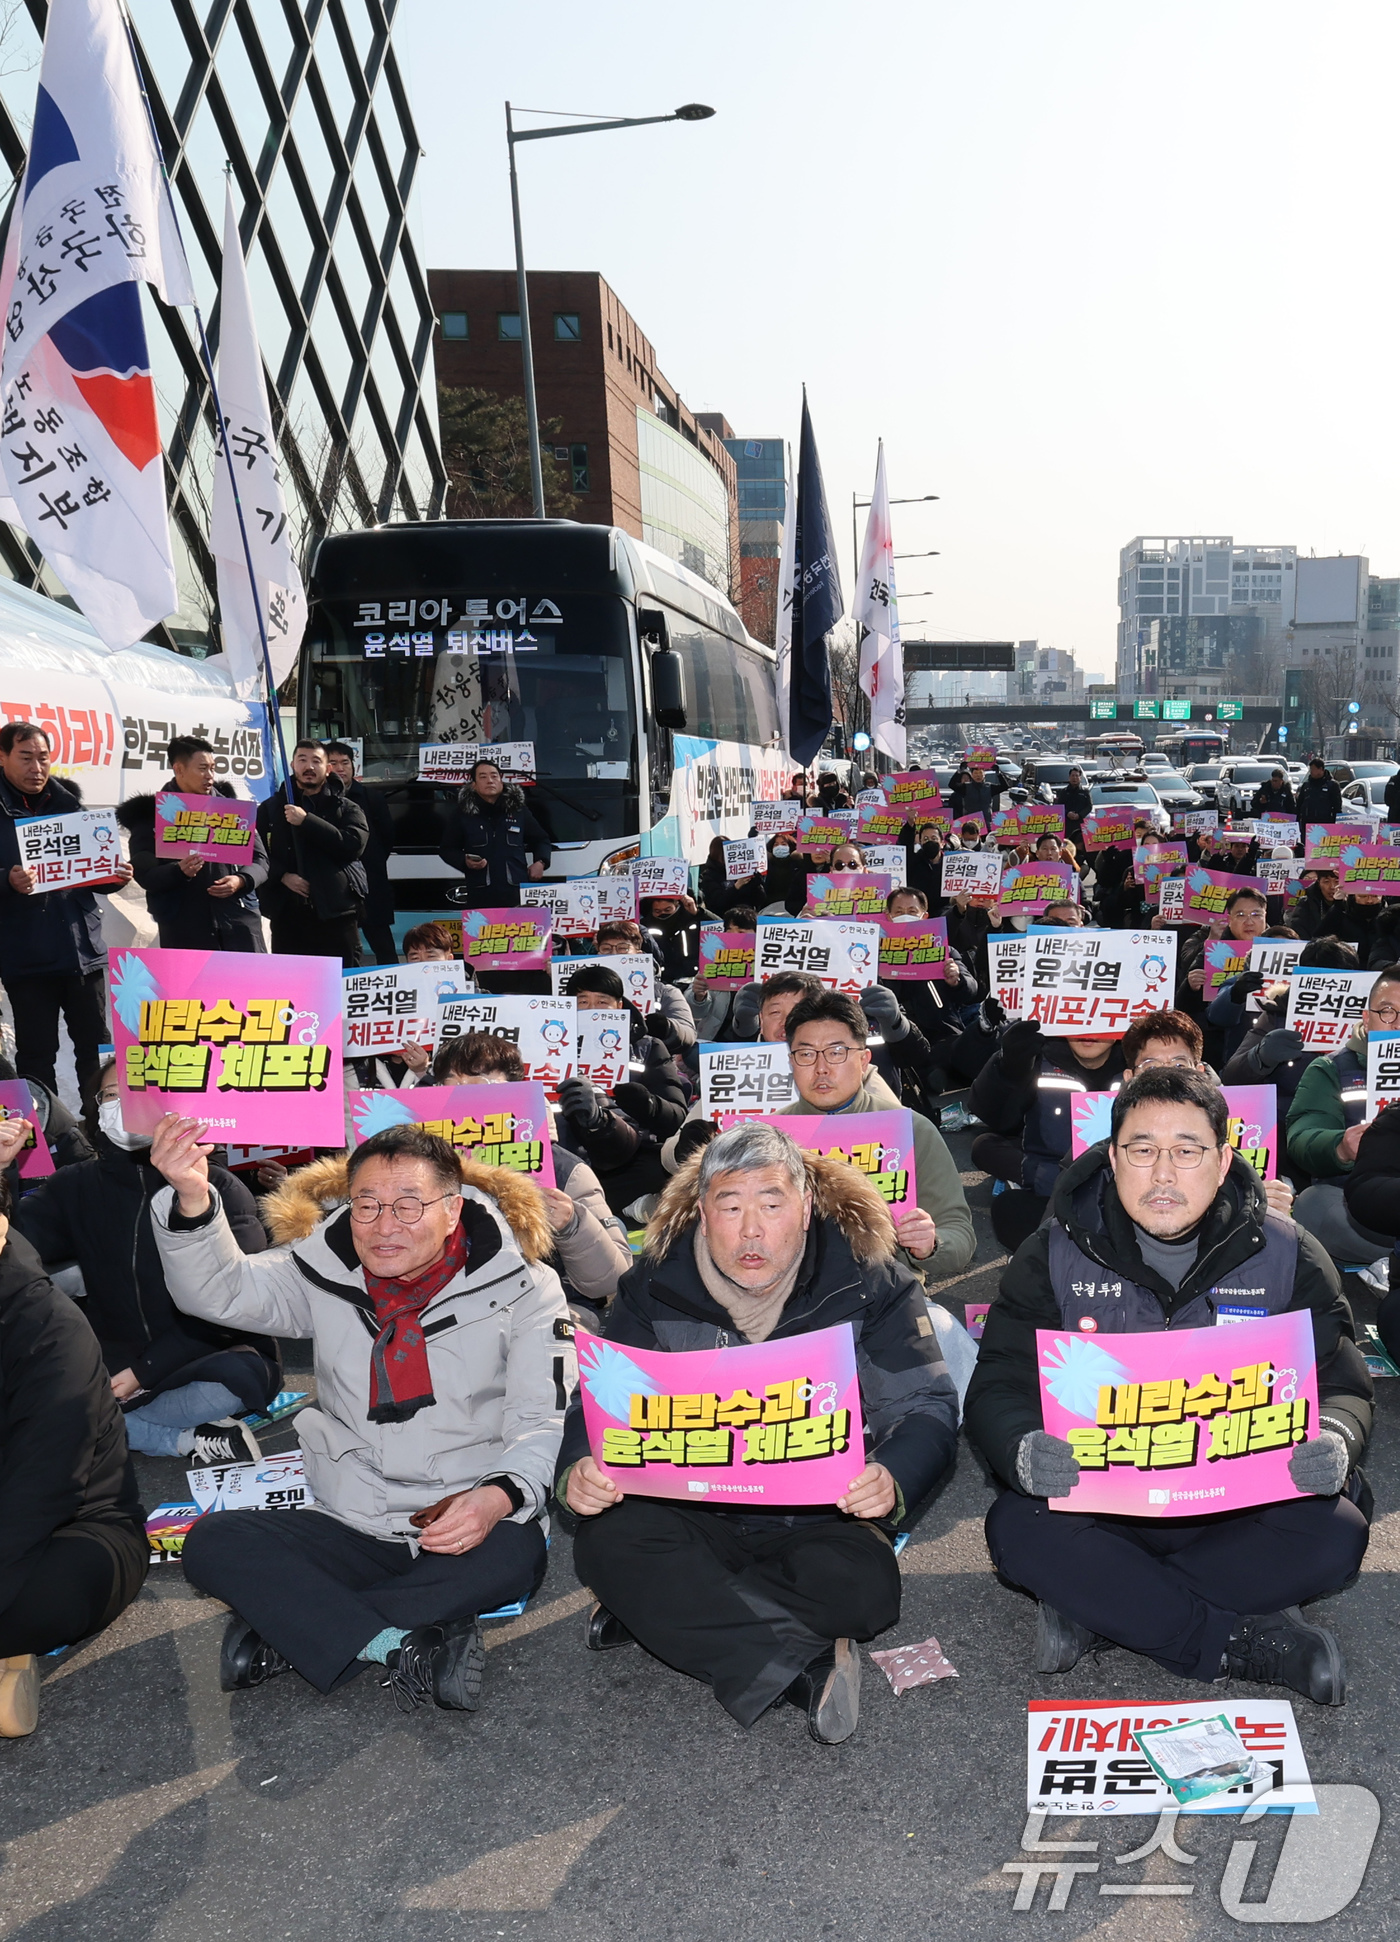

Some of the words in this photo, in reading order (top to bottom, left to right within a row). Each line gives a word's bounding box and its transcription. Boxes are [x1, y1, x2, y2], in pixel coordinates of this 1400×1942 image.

[15, 372, 111, 506] 노동조합
[353, 599, 452, 627] 코리아
[460, 598, 563, 626] 투어스
[365, 630, 434, 658] 윤석열
[447, 629, 538, 655] 퇴진버스
[424, 750, 478, 766] 내란공범
[892, 779, 928, 794] 내란수괴
[889, 792, 914, 804] 윤석열
[914, 787, 936, 801] 체포!
[89, 811, 112, 821] 한국노총
[175, 810, 240, 830] 내란수괴
[754, 810, 782, 820] 윤석열
[870, 816, 904, 826] 내란수괴
[1026, 813, 1060, 825] 내란수괴
[1186, 817, 1205, 825] 윤석열
[22, 823, 63, 838] 내란수괴
[808, 826, 843, 836] 내란수괴
[862, 824, 890, 834] 윤석열
[1020, 823, 1046, 834] 윤석열
[1094, 824, 1125, 836] 내란수괴
[1256, 827, 1281, 839] 윤석열
[162, 826, 209, 843] 윤석열
[211, 829, 252, 847] 체포!
[801, 835, 827, 844] 윤석열
[829, 836, 847, 845] 체포!
[1091, 834, 1113, 844] 윤석열
[1113, 830, 1133, 842] 체포!
[1320, 834, 1361, 847] 내란수괴
[25, 834, 81, 860] 윤석열
[726, 843, 748, 851] 내란수괴
[1310, 846, 1340, 859] 윤석열
[727, 850, 755, 863] 윤석열
[945, 855, 970, 864] 내란수괴
[29, 853, 120, 884] 체포!구속!
[632, 860, 656, 870] 내란수괴
[728, 861, 767, 876] 체포!구속
[945, 864, 978, 878] 윤석열
[1259, 862, 1283, 870] 내란수괴
[632, 867, 665, 880] 윤석열
[1259, 869, 1290, 881] 윤석열
[1344, 868, 1380, 882] 윤석열
[639, 881, 686, 895] 포!구속!
[943, 878, 997, 894] 체포!구속!
[1012, 874, 1061, 890] 내란수괴
[1164, 881, 1183, 891] 내란수
[525, 889, 557, 899] 내란수괴
[824, 886, 878, 901] 내란수괴
[1001, 887, 1038, 904] 윤석열
[1040, 886, 1069, 901] 체포!
[1201, 885, 1238, 900] 내란
[814, 901, 854, 916] 윤석열
[856, 899, 887, 914] 체포!
[1189, 894, 1228, 914] 윤석열
[478, 922, 535, 940] 내란수괴
[704, 925, 724, 933] 내란수
[763, 926, 814, 944] 내란수괴
[848, 926, 876, 936] 한국노총
[1142, 934, 1174, 945] 한국노총
[468, 938, 509, 957] 윤석열
[880, 950, 908, 964] 석열
[911, 946, 946, 964] 체포!
[1035, 938, 1101, 958] 내란수괴
[628, 957, 650, 965] 한국노총
[714, 948, 755, 964] 내란수
[760, 943, 831, 972] 윤석열
[432, 964, 461, 973] 한국노총
[703, 963, 748, 979] 윤석열
[1031, 958, 1122, 992] 윤석열
[345, 974, 397, 992] 내란수괴
[1299, 976, 1352, 993] 내란수괴
[347, 988, 418, 1018] 윤석열
[540, 1000, 573, 1010] 한국노총
[1295, 991, 1368, 1018] 윤석열
[442, 1004, 497, 1022] 내란수괴
[600, 1012, 627, 1022] 한국노총
[139, 999, 294, 1045] 내란수괴
[347, 1017, 437, 1047] 체포!구
[126, 1044, 212, 1092] 윤석열
[216, 1044, 331, 1092] 체포!
[709, 1053, 773, 1070] 내란수괴
[709, 1072, 794, 1103] 윤석열
[410, 1111, 516, 1146] 란수괴
[868, 1170, 909, 1202] 포!
[1071, 1281, 1096, 1297] 단결
[1097, 1281, 1122, 1298] 투쟁
[1095, 1361, 1275, 1427] 내란수괴
[629, 1377, 812, 1430] 내란수괴
[602, 1427, 734, 1468] 윤석열
[741, 1408, 852, 1464] 체포!
[1066, 1421, 1200, 1472] 윤석열
[1206, 1397, 1311, 1464] 체포!
[710, 1483, 765, 1493] 전국금융산업노동조합
[1171, 1486, 1226, 1501] 전국금융산업노동조합
